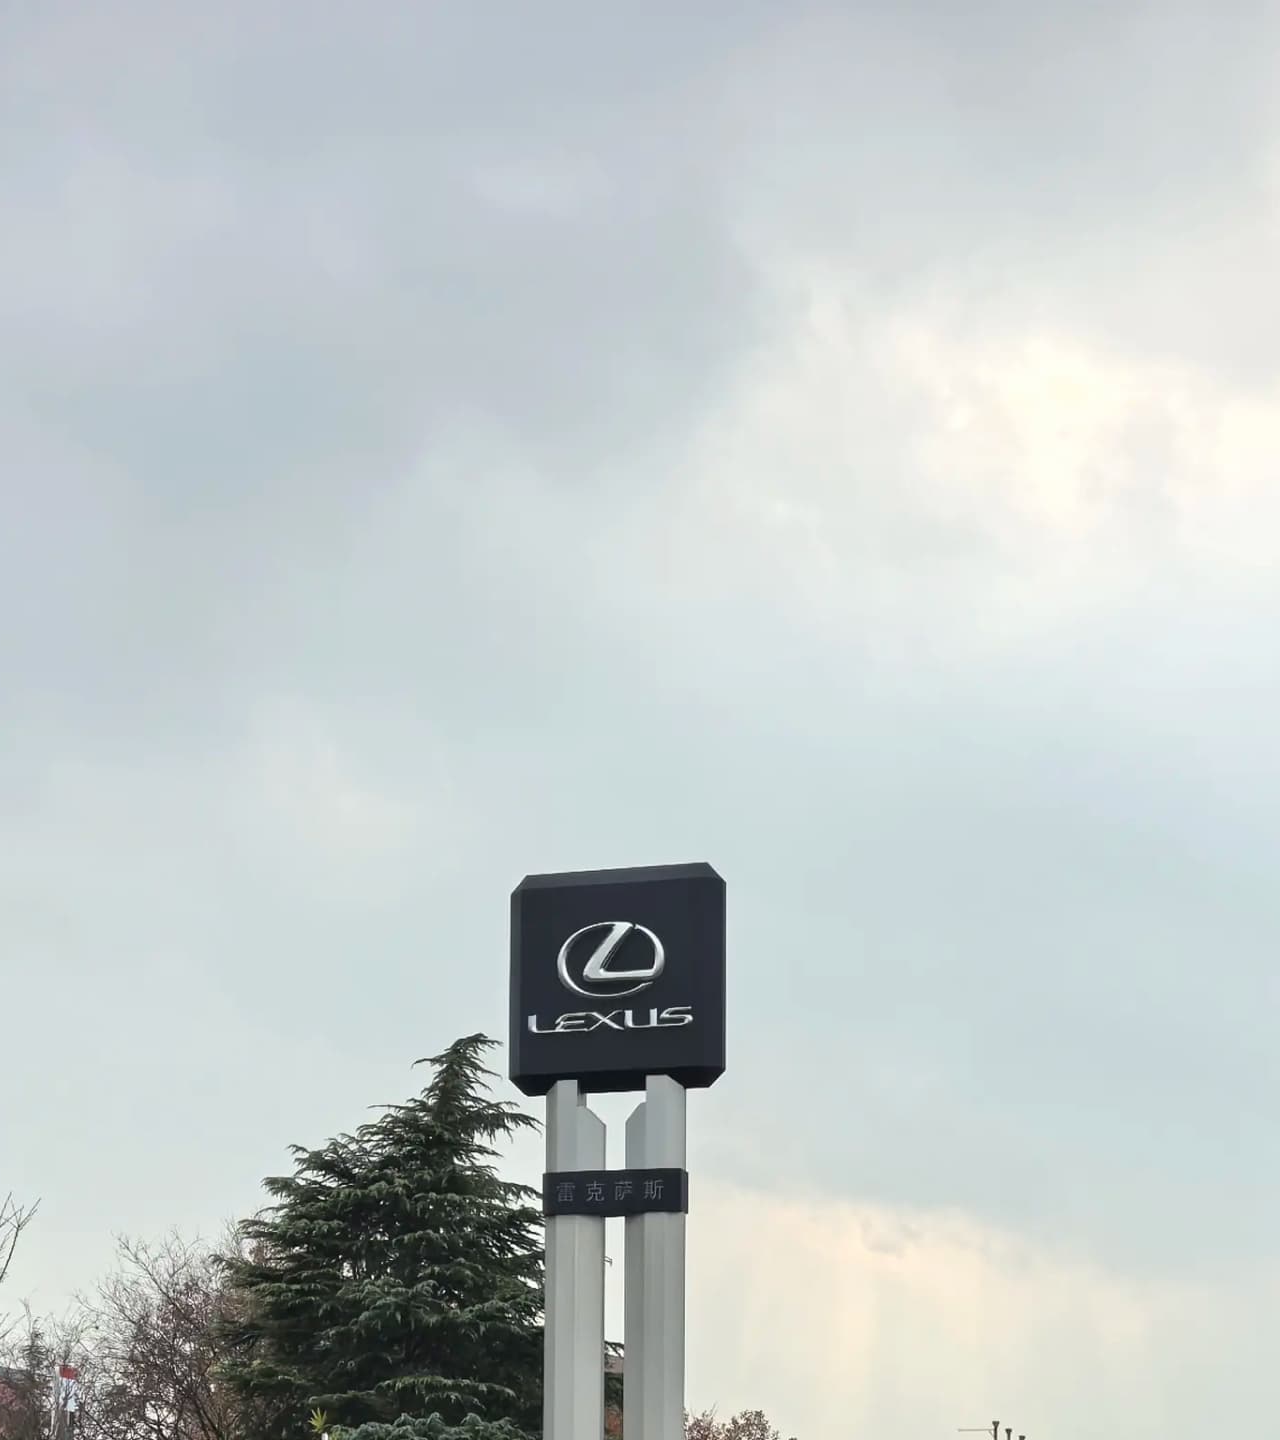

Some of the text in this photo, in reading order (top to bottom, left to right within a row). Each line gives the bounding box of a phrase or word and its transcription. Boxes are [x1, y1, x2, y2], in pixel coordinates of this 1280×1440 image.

[527, 1006, 694, 1034] LEXUS
[555, 1179, 665, 1202] 雷克萨斯
